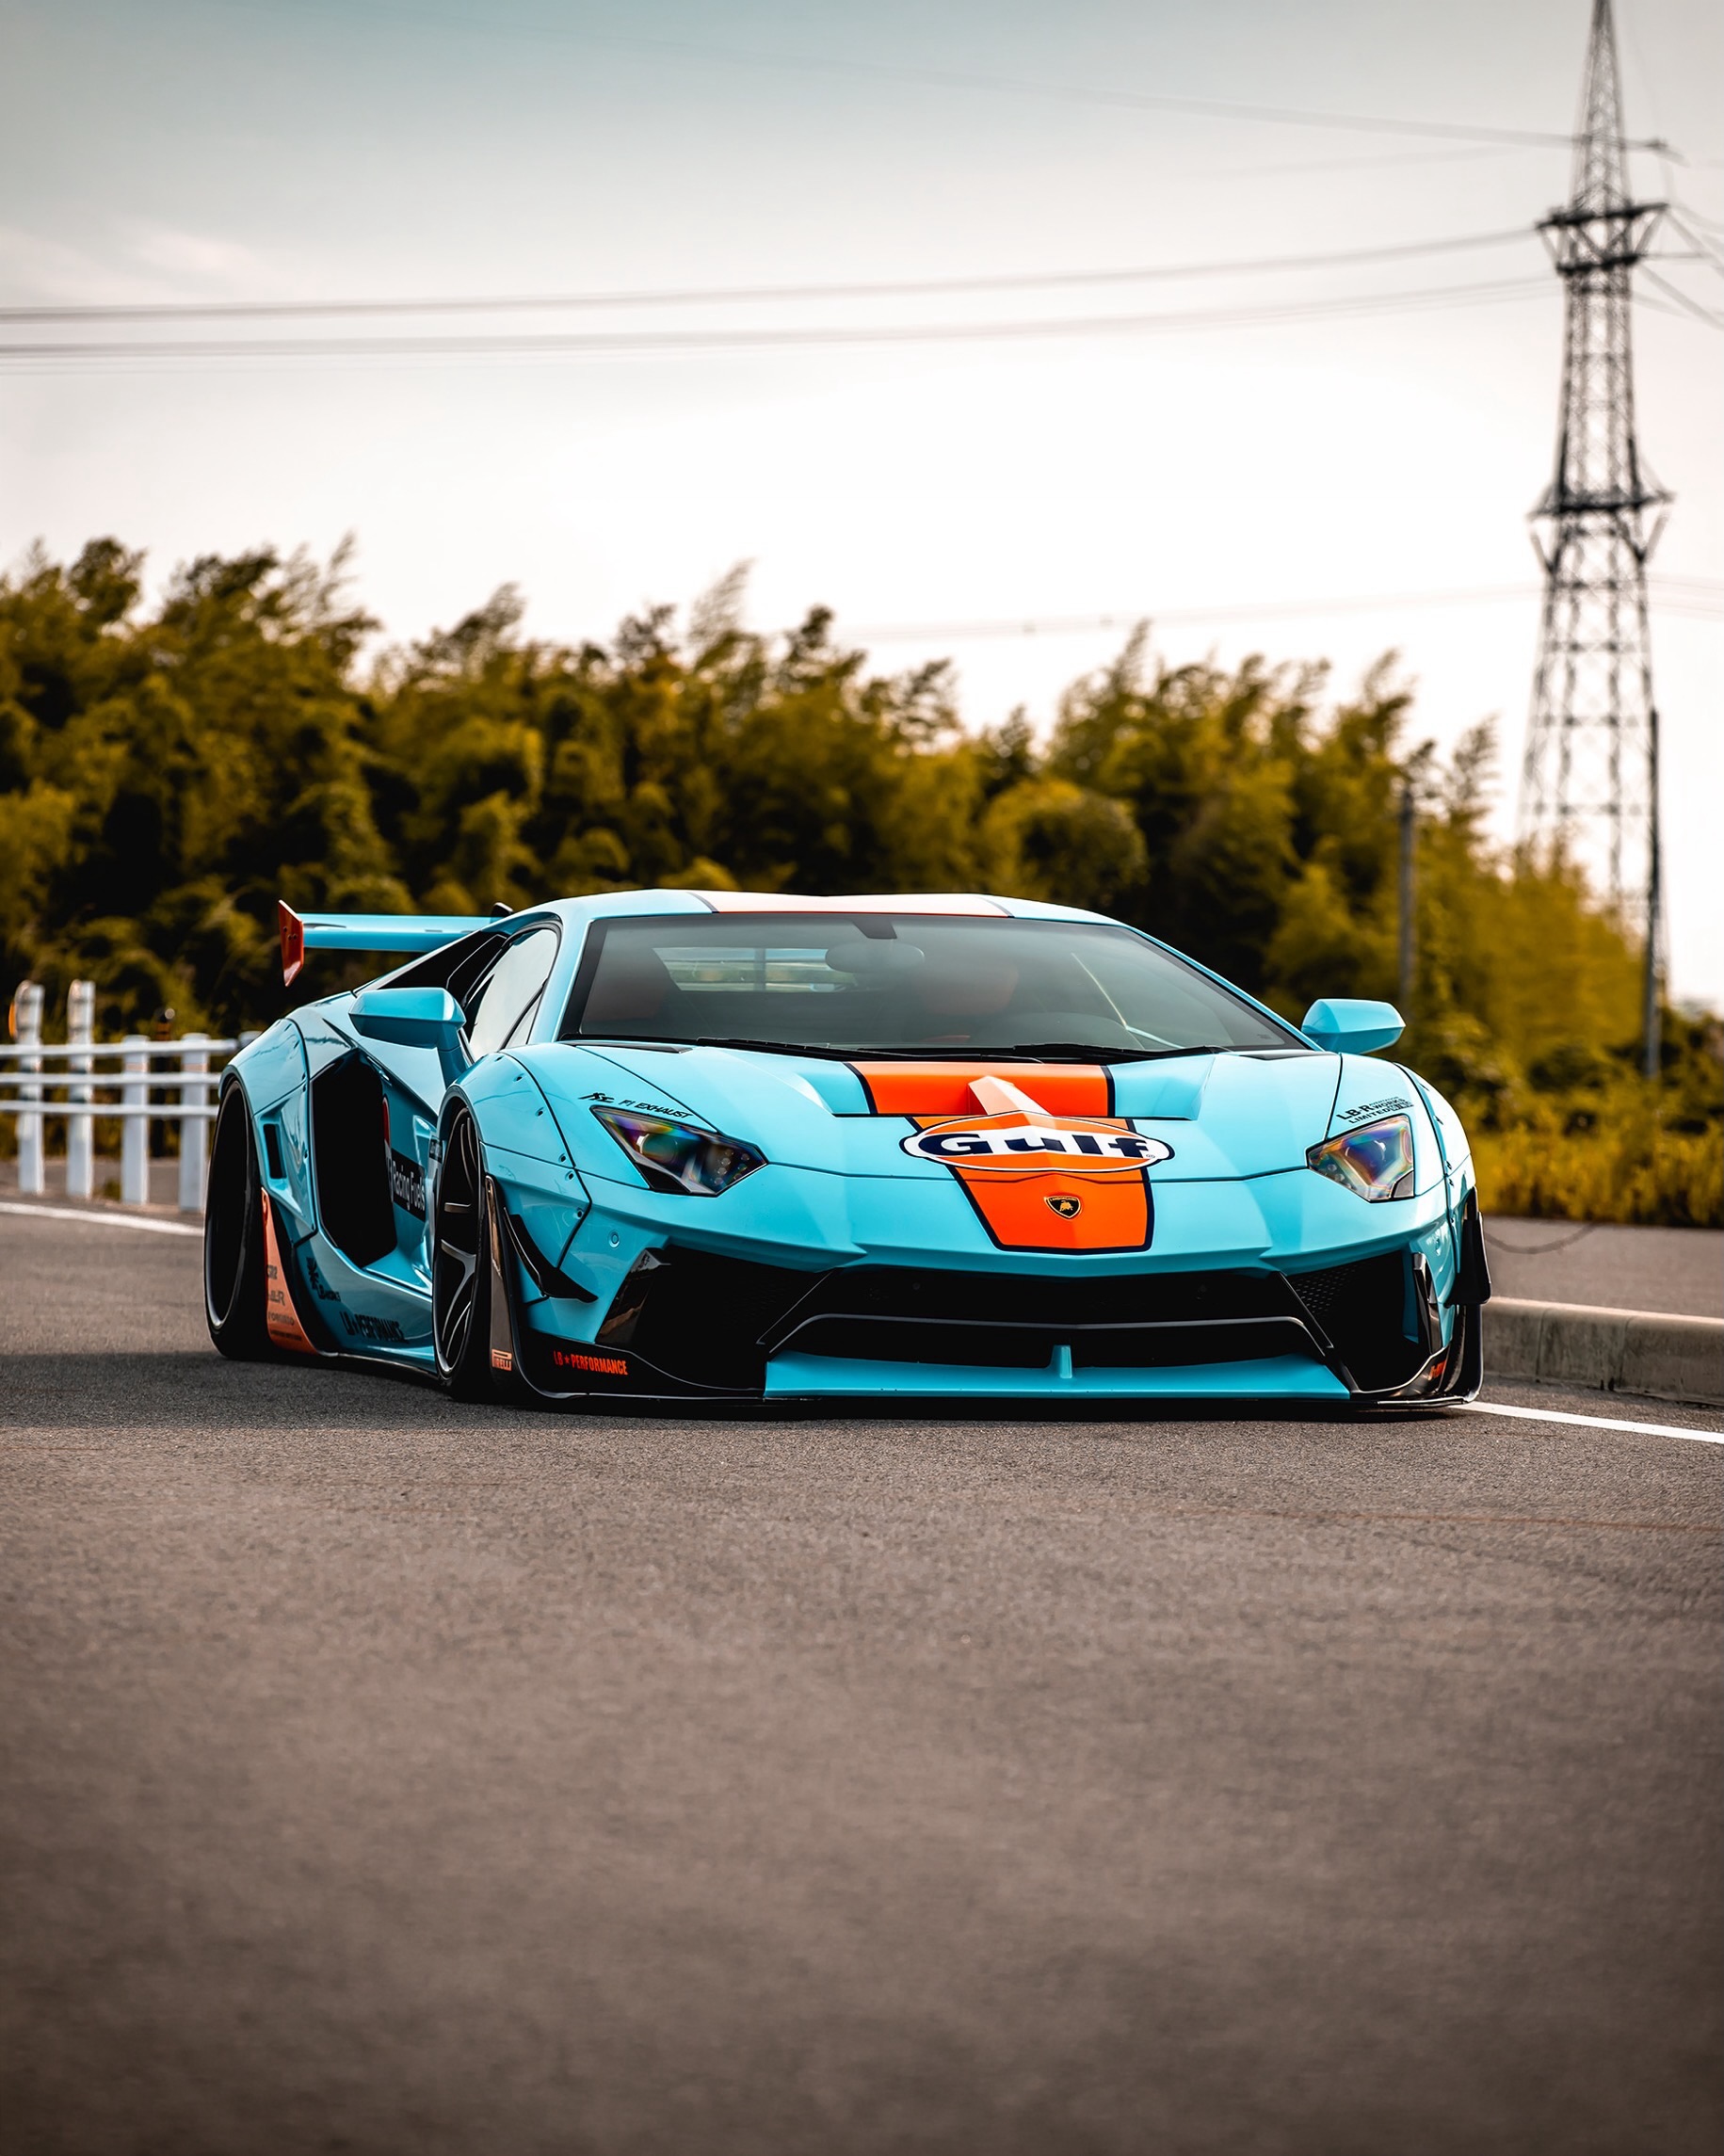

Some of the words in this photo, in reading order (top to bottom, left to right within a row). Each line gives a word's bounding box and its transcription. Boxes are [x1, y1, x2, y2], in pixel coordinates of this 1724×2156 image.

[635, 1102, 693, 1118] EXHAUST
[1348, 1106, 1390, 1124] LIMITED
[918, 1133, 1149, 1159] Gulf
[393, 1160, 411, 1211] Racing
[411, 1171, 426, 1211] Fuels
[491, 1348, 512, 1372] PIRELLI
[554, 1350, 564, 1366] LB
[571, 1354, 629, 1376] PERFORMANCE
